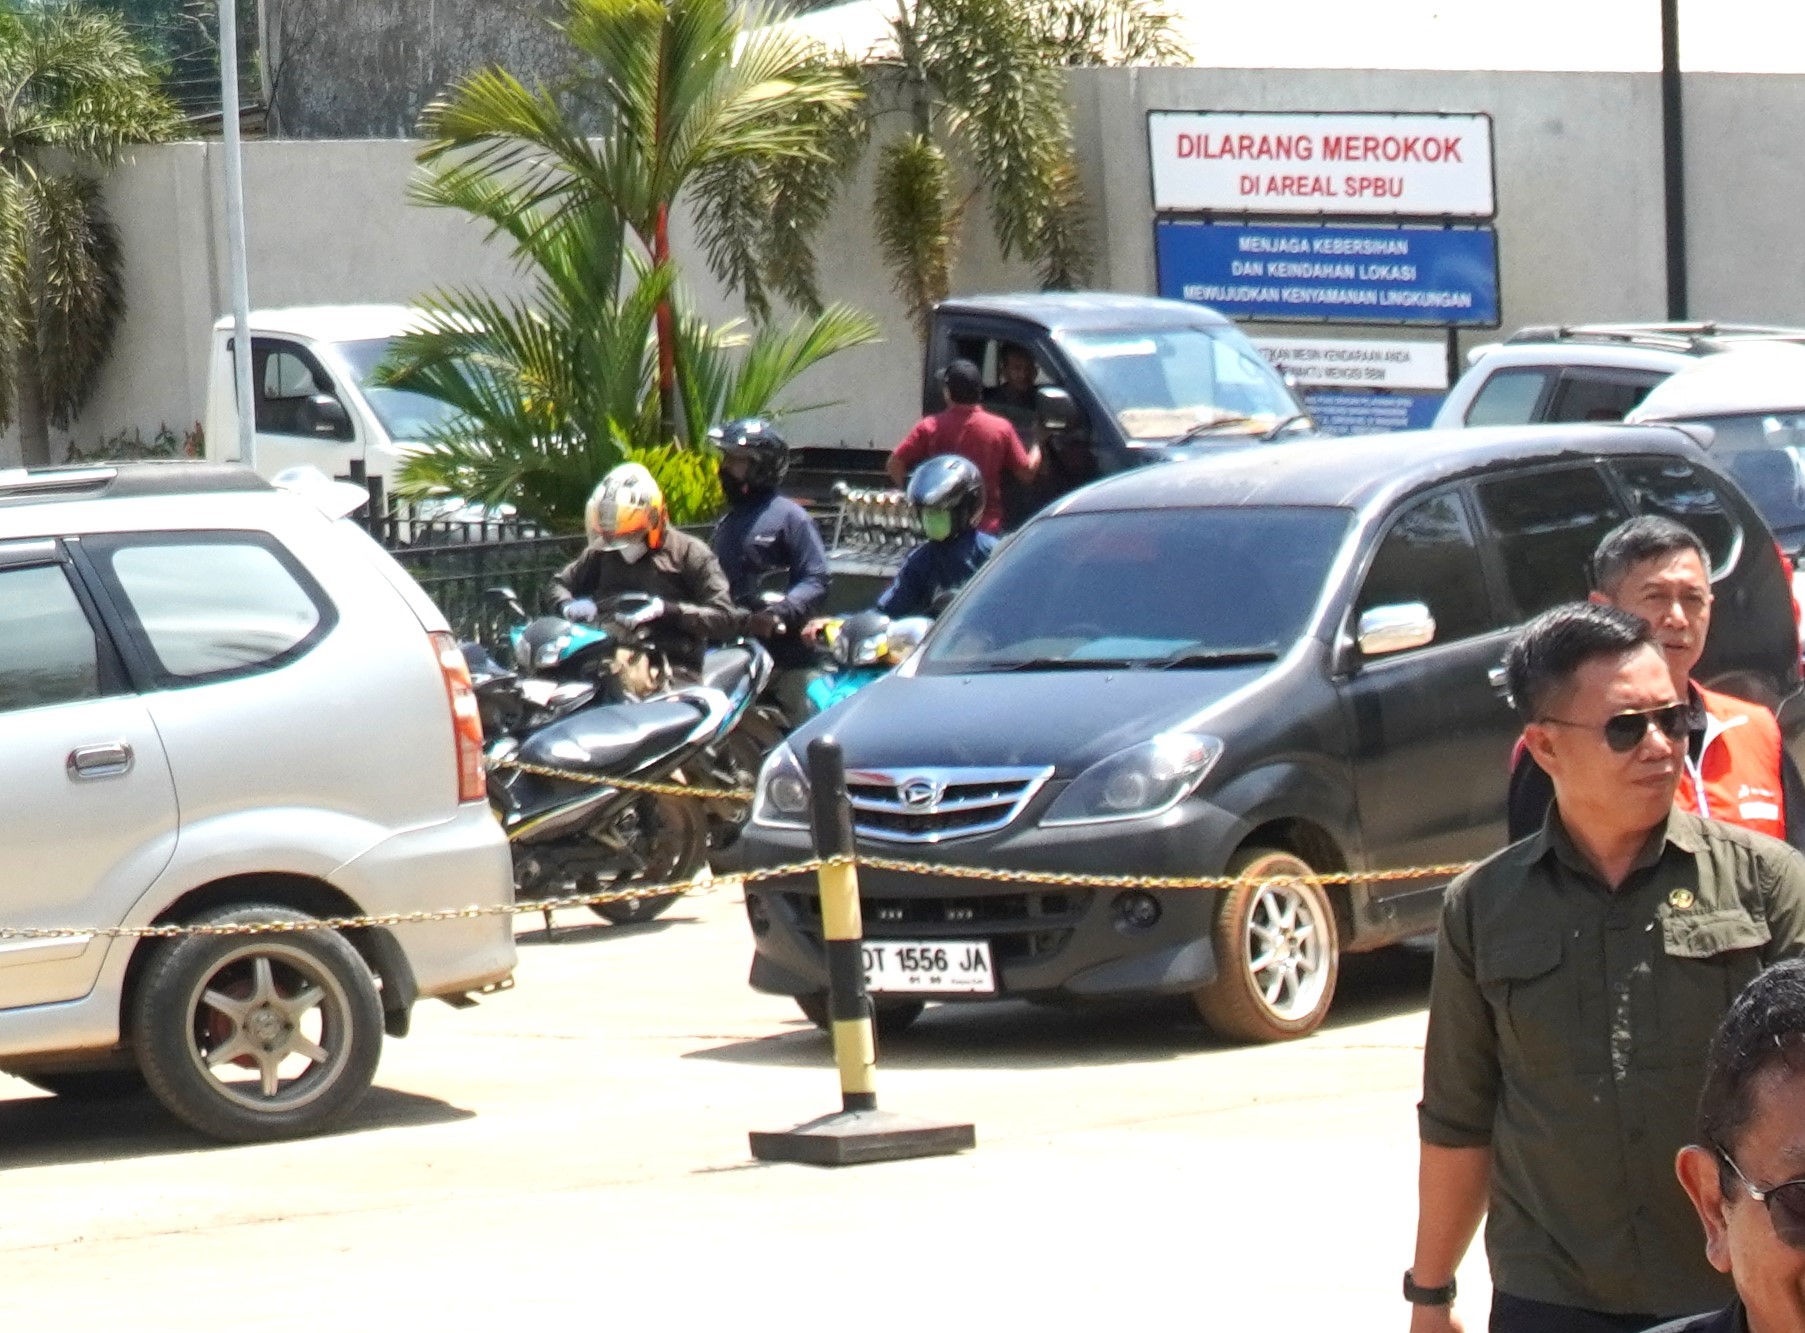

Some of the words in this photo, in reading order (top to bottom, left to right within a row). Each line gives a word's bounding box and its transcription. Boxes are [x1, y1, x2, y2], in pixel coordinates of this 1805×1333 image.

[1177, 134, 1313, 161] DILARANG
[1322, 136, 1463, 162] MEROKOK
[1240, 175, 1260, 196] DI
[1265, 176, 1337, 196] AREAL
[1344, 177, 1404, 197] SPBU
[1238, 236, 1310, 254] MENJAGA
[1312, 238, 1409, 255] KEBERSIHAN
[1231, 260, 1263, 277] DAN
[1267, 262, 1355, 279] KEINDAHAN
[1359, 264, 1417, 282] LOKASI
[1183, 285, 1280, 302] MEWUJUDKAN
[1281, 287, 1377, 305] KENYAMANAN
[1379, 290, 1472, 308] LINGKUNGAN
[895, 947, 948, 972] 1556
[959, 947, 988, 972] JA
